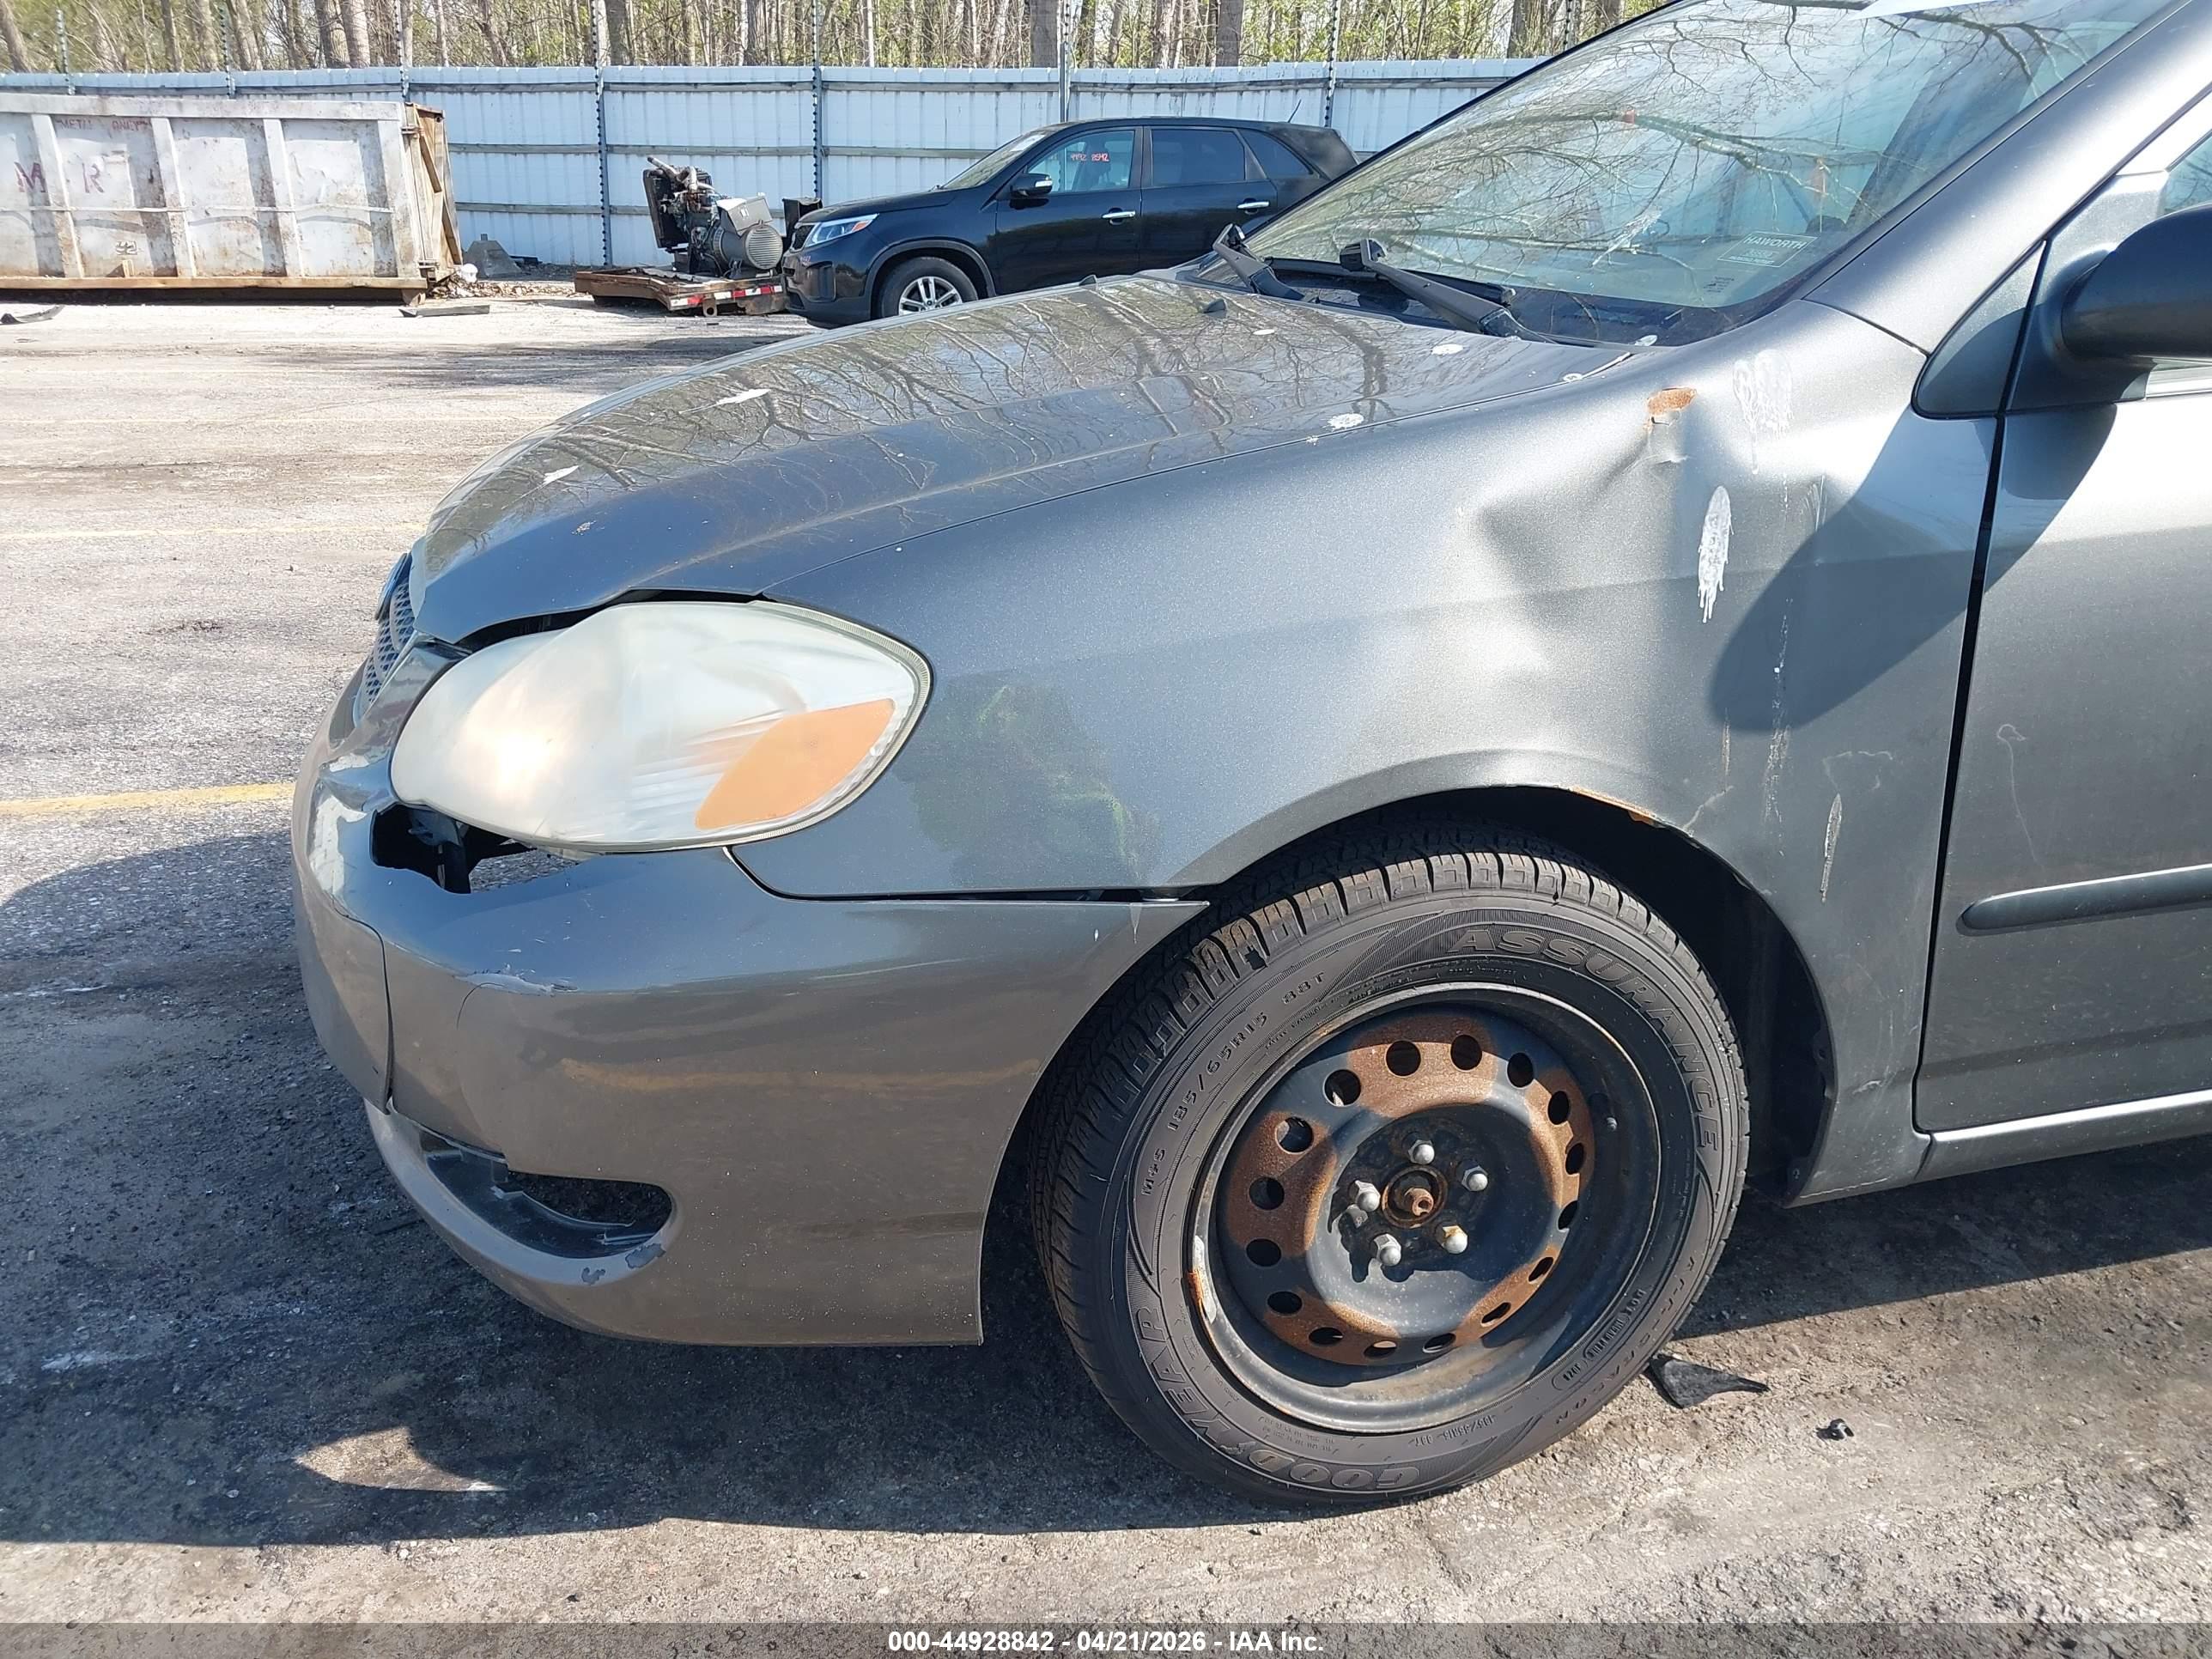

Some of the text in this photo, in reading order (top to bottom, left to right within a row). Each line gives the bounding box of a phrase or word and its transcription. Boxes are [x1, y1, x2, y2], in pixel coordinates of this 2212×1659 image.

[1743, 236, 1808, 250] HAWORTH
[1167, 1011, 1268, 1131] 185/65R15
[1281, 971, 1324, 1005] 88T
[1446, 929, 1718, 1151] ASSURANCE
[1135, 1306, 1420, 1489] GOODYEAR
